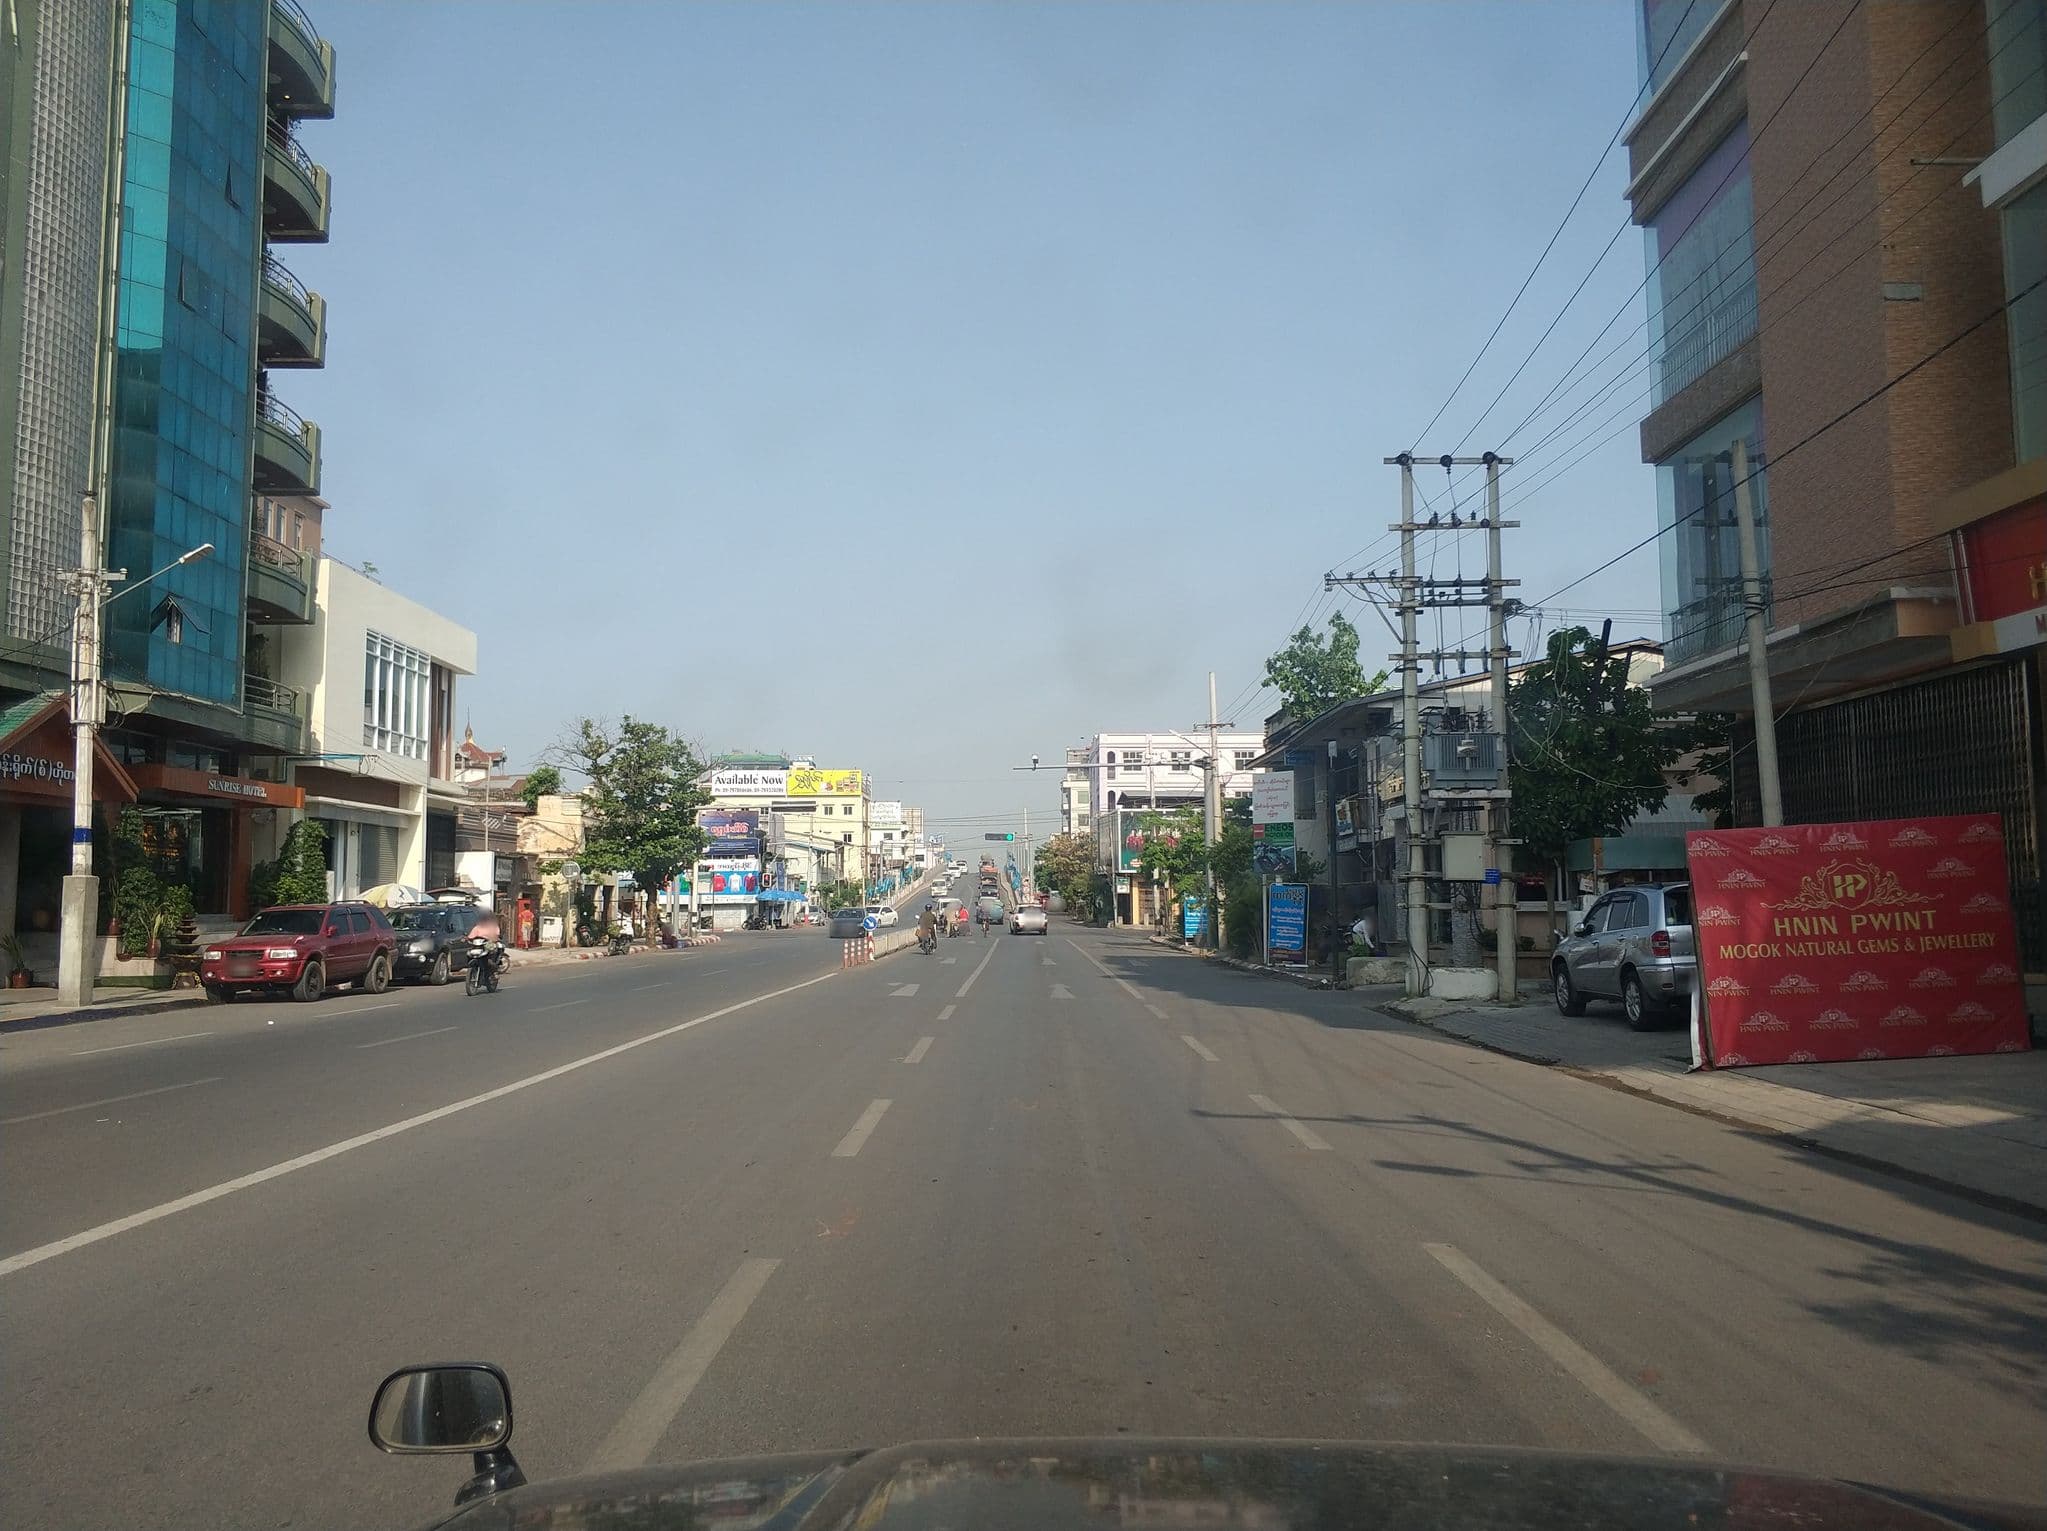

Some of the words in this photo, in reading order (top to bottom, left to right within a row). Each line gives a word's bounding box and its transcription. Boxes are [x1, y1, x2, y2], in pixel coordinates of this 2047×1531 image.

[208, 779, 241, 793] SUNRISE
[243, 784, 267, 798] HOTEL
[714, 774, 758, 785] Available
[761, 776, 783, 785] Now
[1264, 822, 1293, 832] ENEOS
[1774, 915, 1838, 938] HNIN
[1851, 909, 1937, 935] PWINT
[1719, 943, 1781, 960] MOGOK
[1785, 940, 1854, 957] NATURAL
[1858, 938, 1899, 954] GEMS
[1904, 937, 1916, 952] &
[1920, 933, 1996, 953] JEWELLERY
